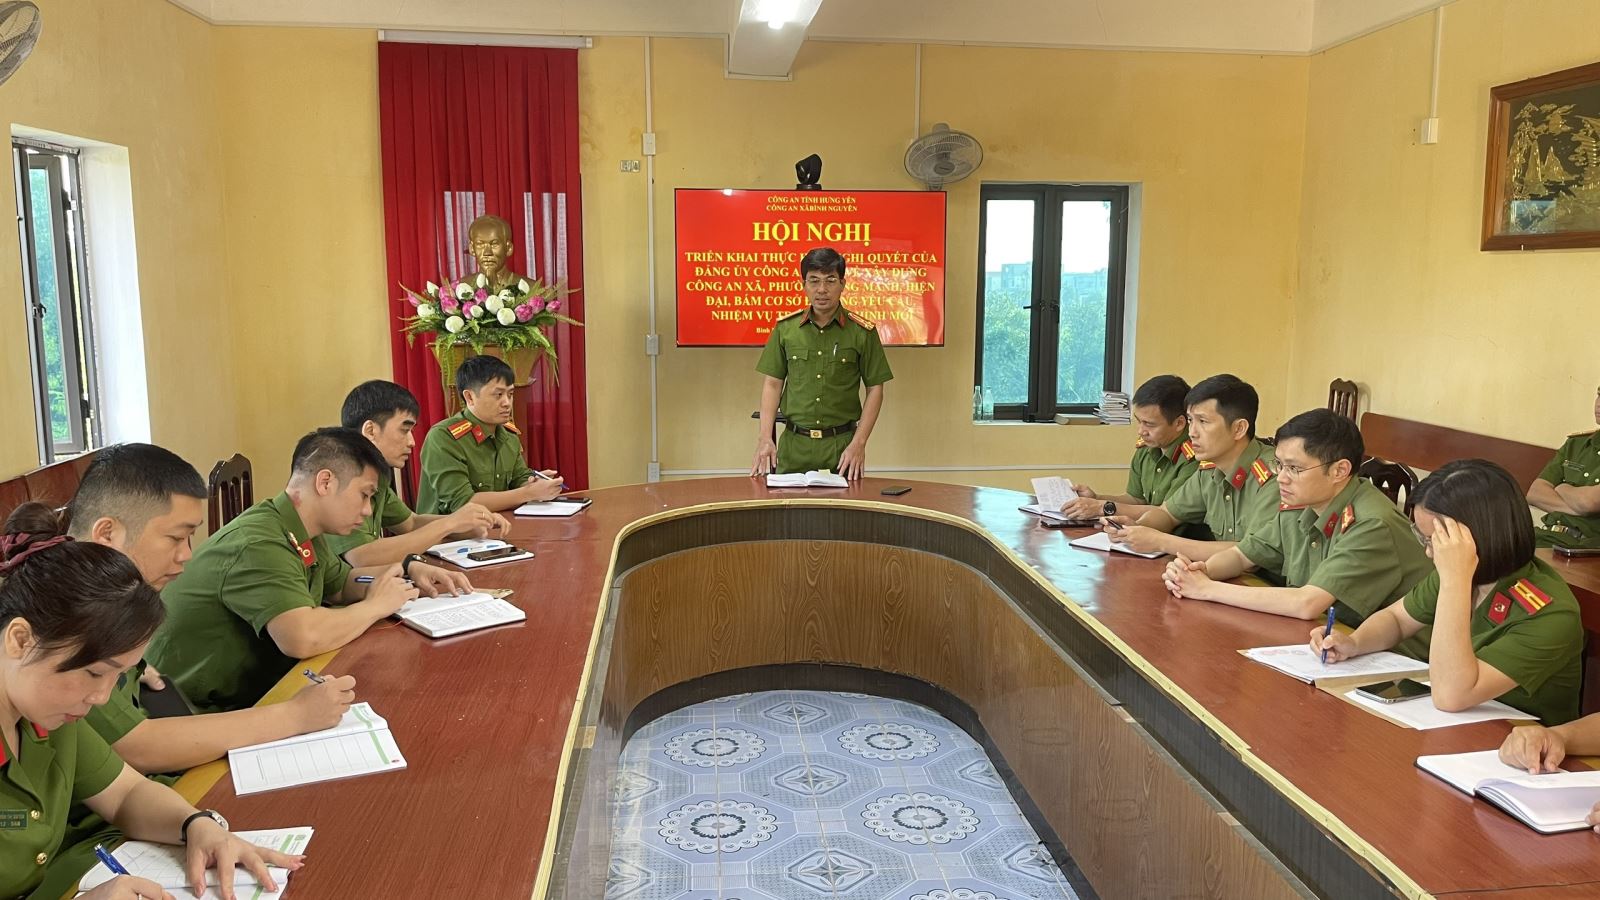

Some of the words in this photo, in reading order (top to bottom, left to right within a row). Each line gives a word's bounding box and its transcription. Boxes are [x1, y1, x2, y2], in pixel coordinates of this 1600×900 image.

[767, 195, 789, 204] CÔNG
[752, 220, 800, 246] HỘI
[806, 222, 871, 246] NGHỊ
[685, 250, 723, 262] TRIỂN
[727, 252, 758, 262] KHAI
[761, 252, 797, 264] THỰC
[841, 253, 864, 264] GHỊ
[868, 251, 909, 264] QUYẾT
[912, 250, 937, 262] CỦA
[754, 265, 789, 276] CÔNG
[686, 280, 722, 291] CÔNG
[725, 282, 741, 291] AN
[746, 280, 766, 292] XÃ,
[768, 280, 804, 292] PHƯỜ
[706, 296, 732, 308] ĐẠI,
[765, 296, 784, 306] CƠ
[712, 309, 753, 322] NHIỆM
[756, 310, 774, 322] VỤ
